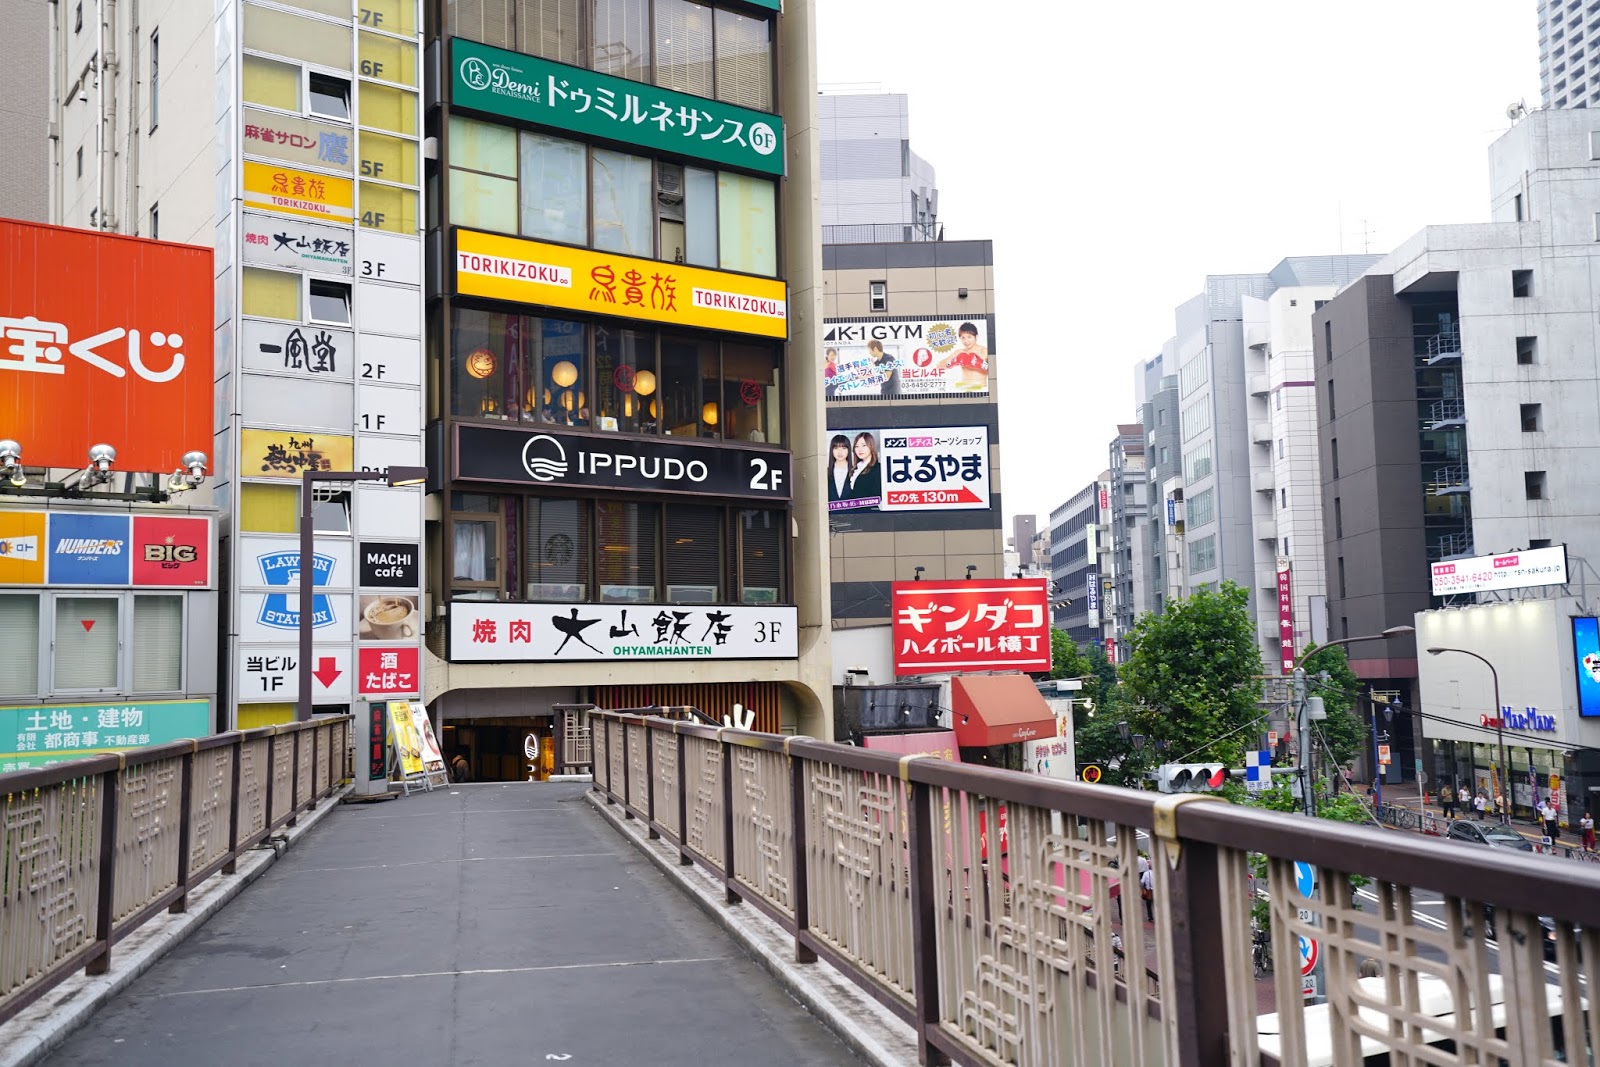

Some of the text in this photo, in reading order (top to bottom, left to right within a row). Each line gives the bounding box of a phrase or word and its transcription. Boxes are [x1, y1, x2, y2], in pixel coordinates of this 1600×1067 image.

[360, 9, 383, 26] 7F
[361, 60, 383, 76] 6F
[492, 68, 540, 97] Demi
[492, 87, 540, 103] RENAISSANCE
[548, 75, 773, 148] ドゥミルネサンス 6F
[244, 125, 316, 149] 麻雀サロン
[361, 160, 383, 176] 5F
[272, 197, 326, 213] TORIKIZOKU
[361, 211, 385, 227] 4F
[245, 232, 350, 257] 焼肉 大山飯店
[362, 261, 385, 277] 3F
[460, 254, 558, 282] TORIKIZOKU
[695, 290, 776, 315] TORIKIZOKU
[838, 325, 922, 340] K-1 GYM
[259, 328, 336, 372] 一風堂
[362, 363, 385, 379] 2F
[362, 414, 385, 430] 1F
[289, 436, 314, 451] 九州
[885, 439, 906, 447] メンズ
[934, 436, 983, 446] スーツショップ
[578, 451, 782, 491] IPPUDO 2F
[886, 454, 982, 483] はるやま
[890, 491, 958, 503] この先 130m
[55, 538, 124, 555] NUMBERS
[144, 544, 197, 562] BIG
[367, 553, 411, 565] MACHI
[375, 566, 404, 578] café
[898, 598, 1043, 633] ギンダコ
[472, 608, 782, 655] 焼肉 大山飯店 3F
[613, 646, 712, 655] OHYAMAHANTEN
[900, 635, 1041, 656] ハイボール横丁
[247, 656, 296, 672] 当ビル
[380, 652, 398, 669] 酒
[260, 677, 284, 691] 1F
[366, 672, 412, 689] たばこ
[25, 707, 143, 732] 土地・建物
[44, 731, 99, 749] 都商事
[104, 733, 150, 746] 不動産部
